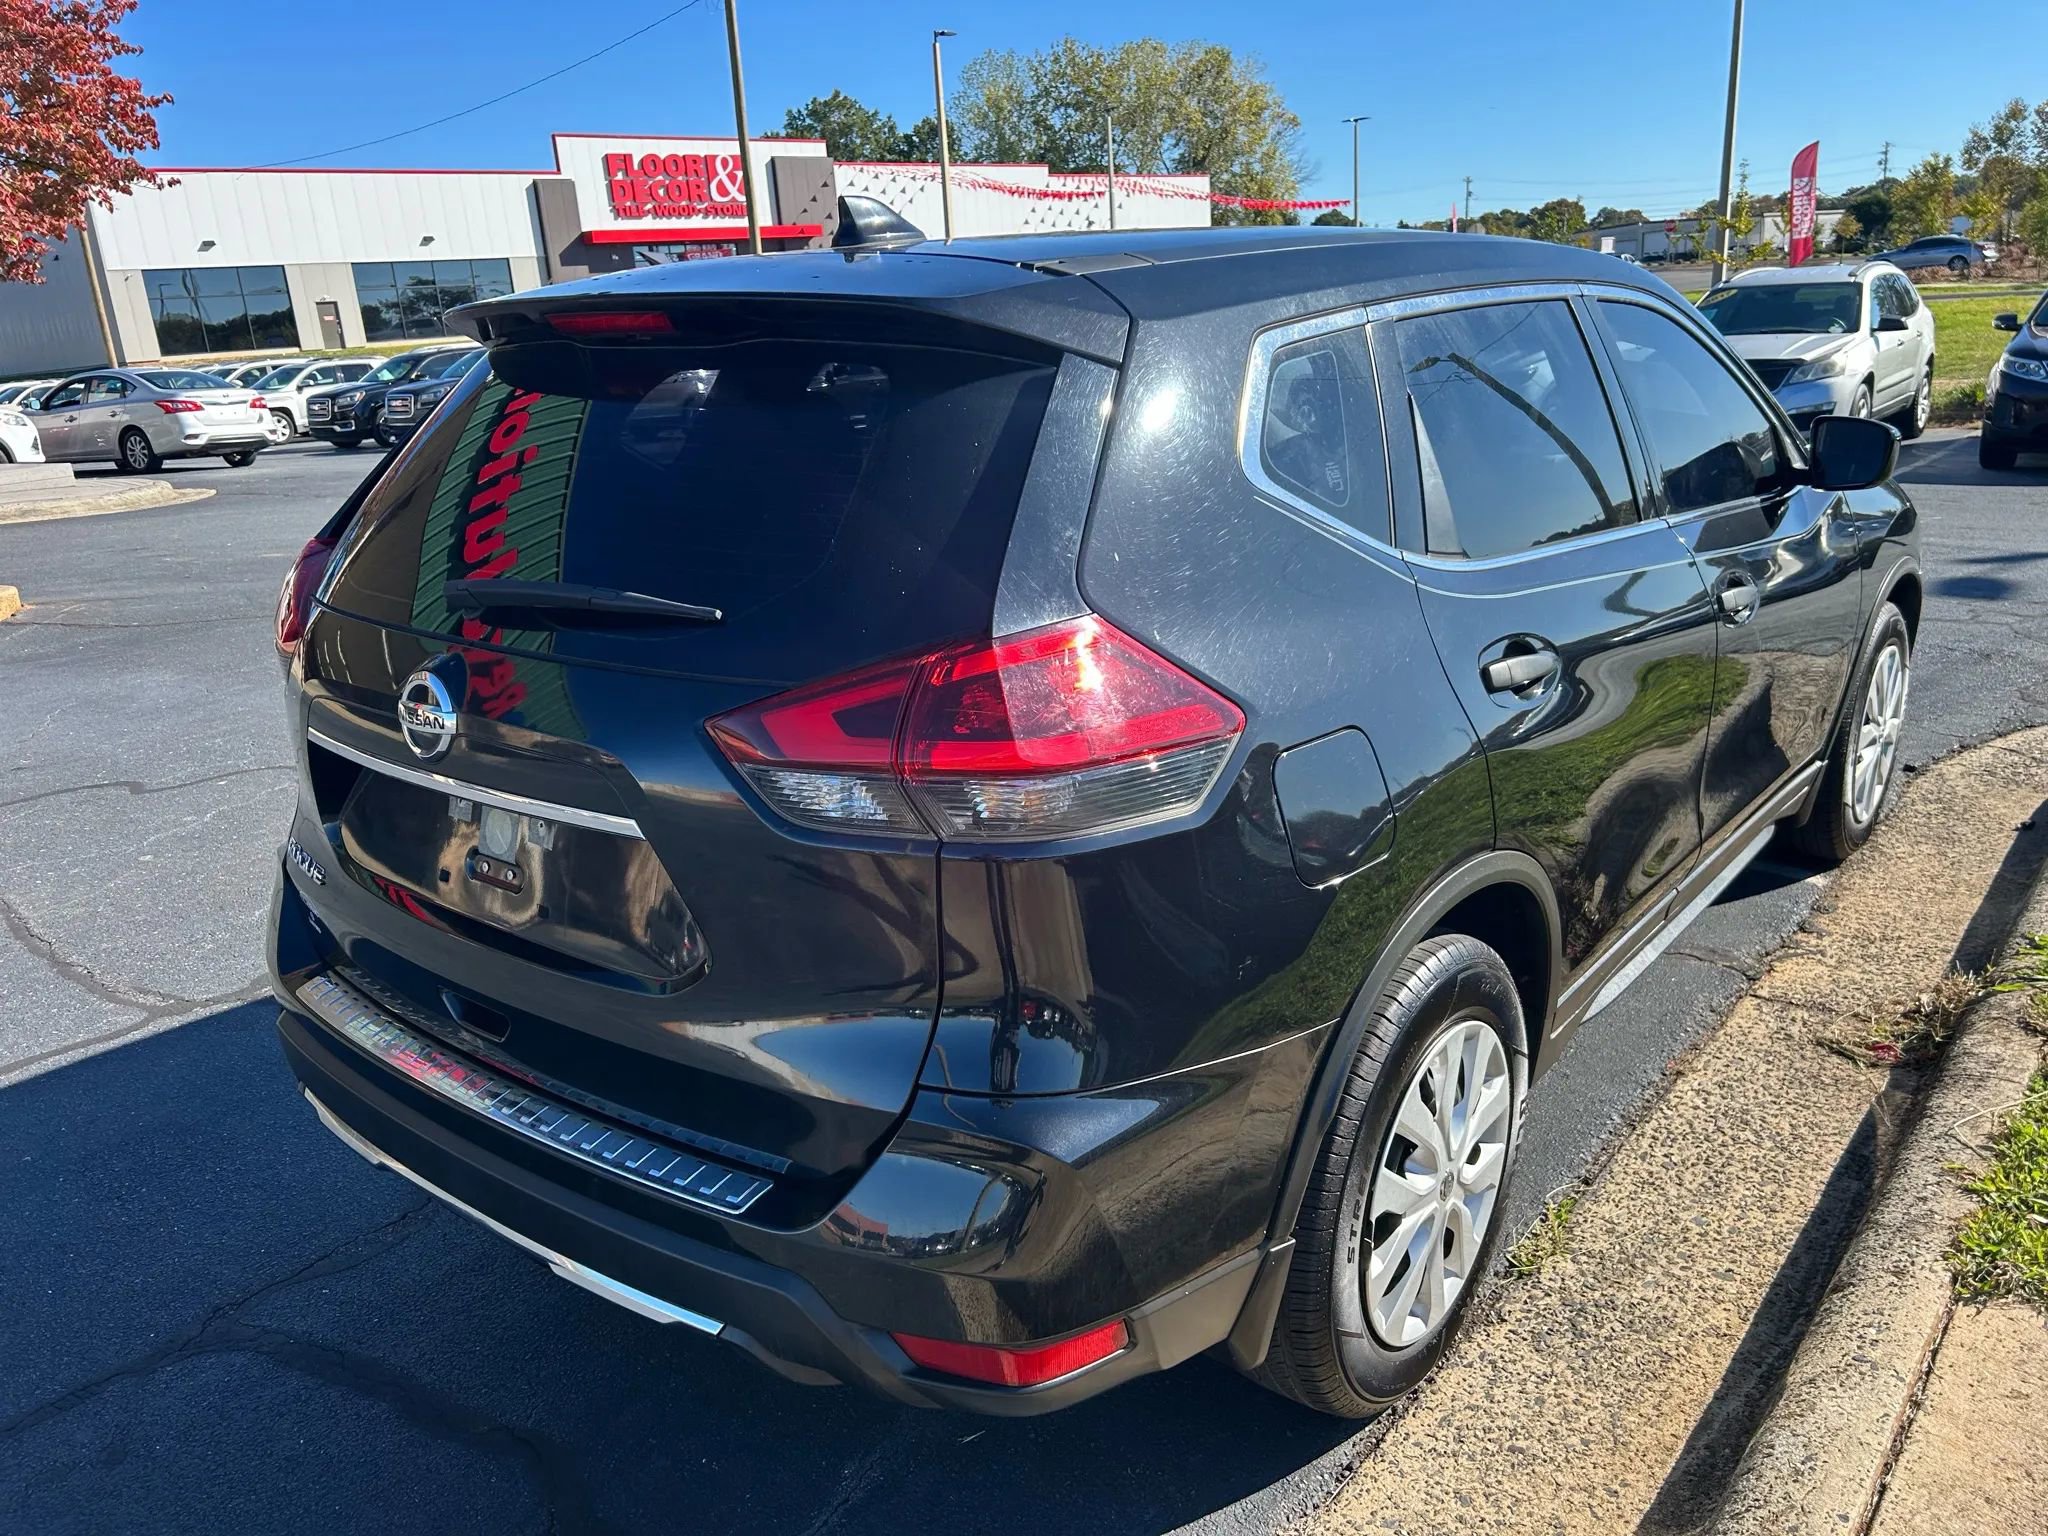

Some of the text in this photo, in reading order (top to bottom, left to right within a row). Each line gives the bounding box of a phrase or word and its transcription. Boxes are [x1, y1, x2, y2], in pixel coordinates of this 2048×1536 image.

[606, 153, 747, 203] FLOOR &
[610, 179, 709, 204] DECOR
[655, 204, 697, 217] WOOD
[1792, 196, 1802, 239] FLOOR
[1801, 196, 1811, 239] DECOR
